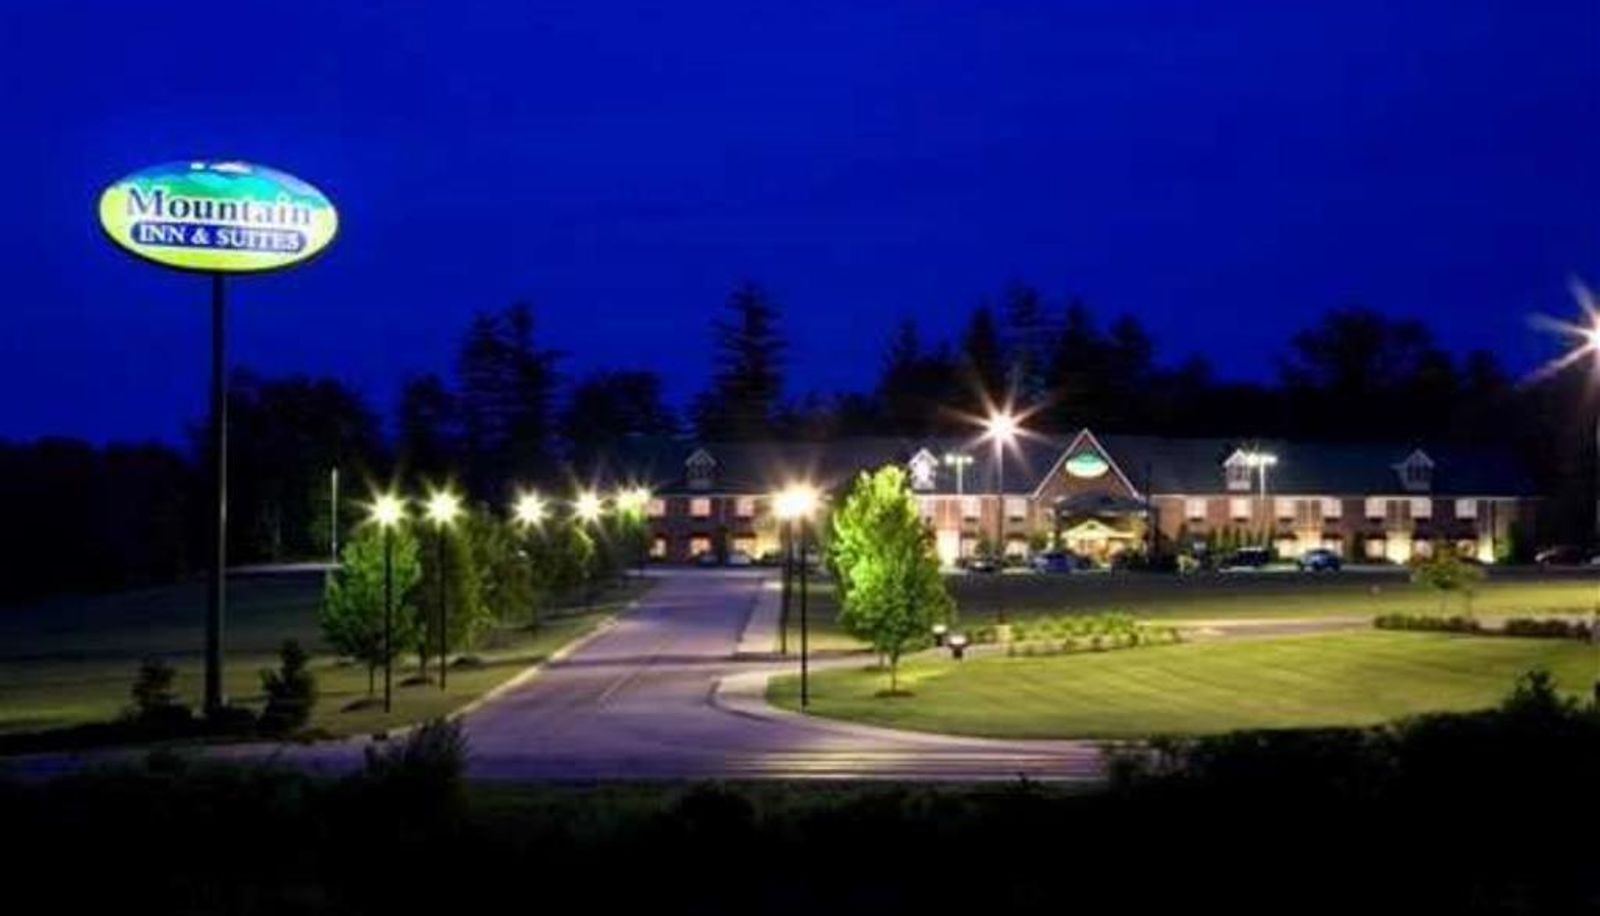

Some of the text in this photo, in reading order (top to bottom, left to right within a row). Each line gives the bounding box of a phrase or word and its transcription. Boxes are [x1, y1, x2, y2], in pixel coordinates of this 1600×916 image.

[126, 187, 312, 224] Mountain
[139, 224, 300, 250] INN & SUITES
